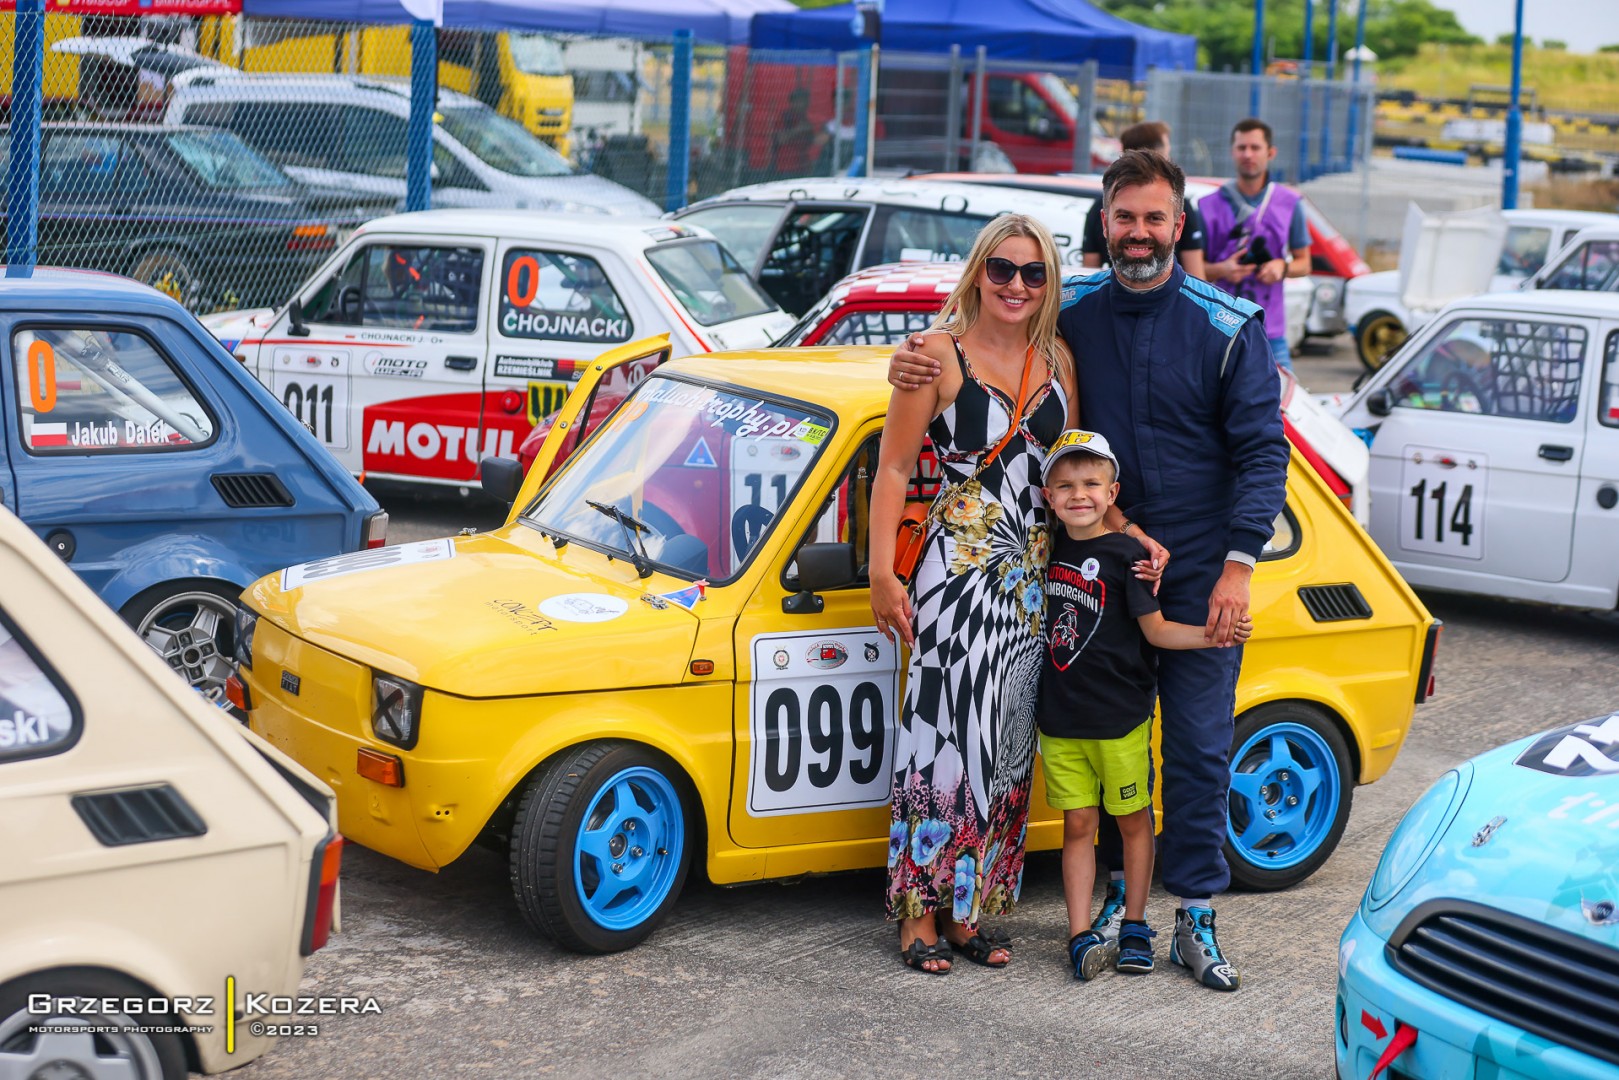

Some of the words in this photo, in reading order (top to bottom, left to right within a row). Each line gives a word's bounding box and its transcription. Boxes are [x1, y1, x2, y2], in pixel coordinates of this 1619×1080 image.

[507, 255, 539, 308] 0
[361, 331, 415, 342] CHOJNACKI
[1216, 310, 1241, 327] OMP
[28, 339, 57, 413] 0
[71, 420, 118, 447] Jakub
[283, 381, 333, 443] 011
[366, 418, 519, 465] MOTUL
[1410, 477, 1474, 547] 114
[764, 681, 886, 793] 099
